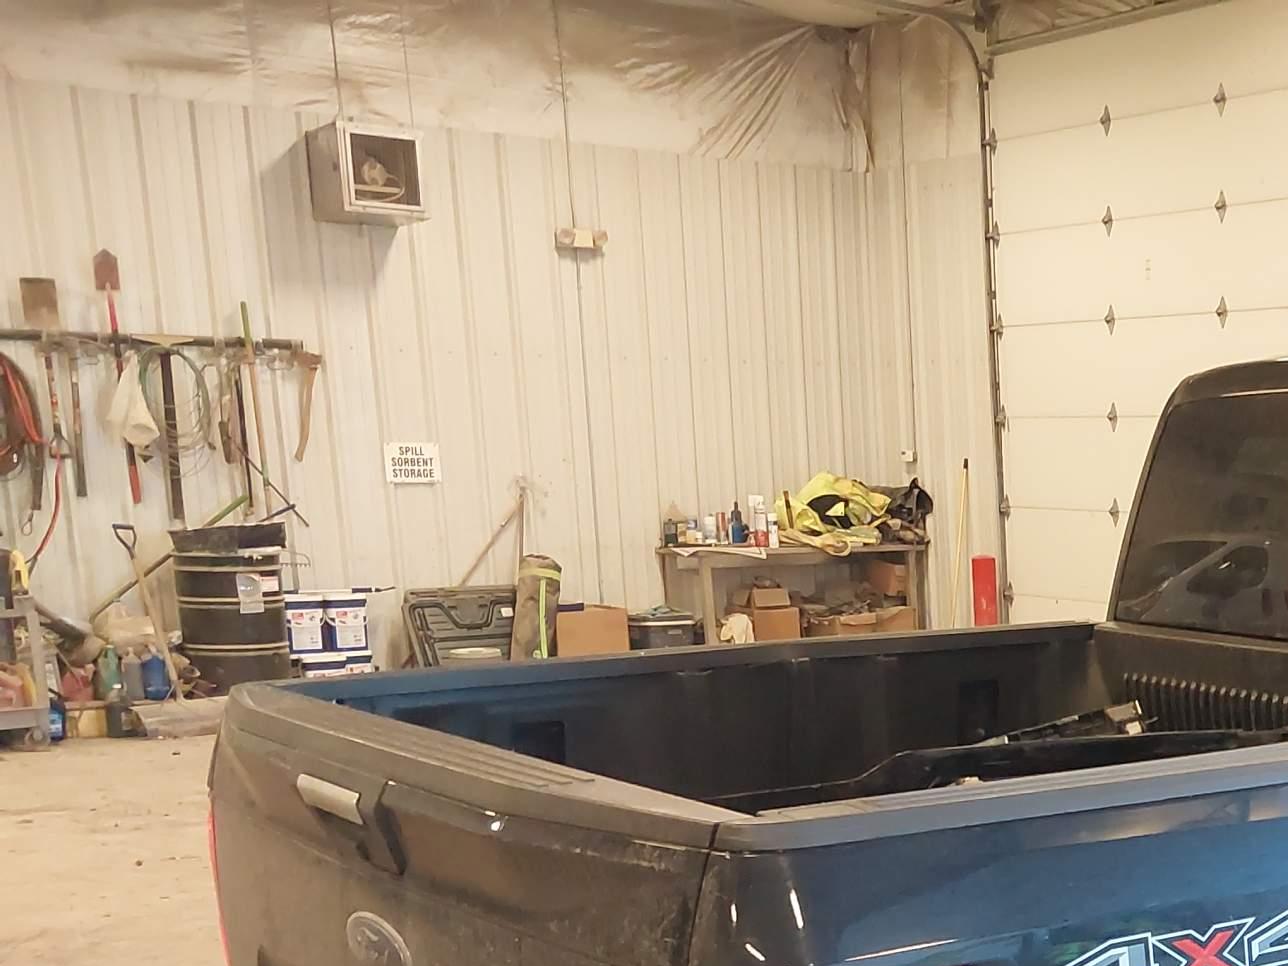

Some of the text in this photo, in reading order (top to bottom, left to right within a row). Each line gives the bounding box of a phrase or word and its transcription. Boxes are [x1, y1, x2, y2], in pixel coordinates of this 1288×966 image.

[398, 446, 425, 456] SPILL
[391, 456, 434, 468] SORBENT
[392, 468, 435, 479] STORAGE
